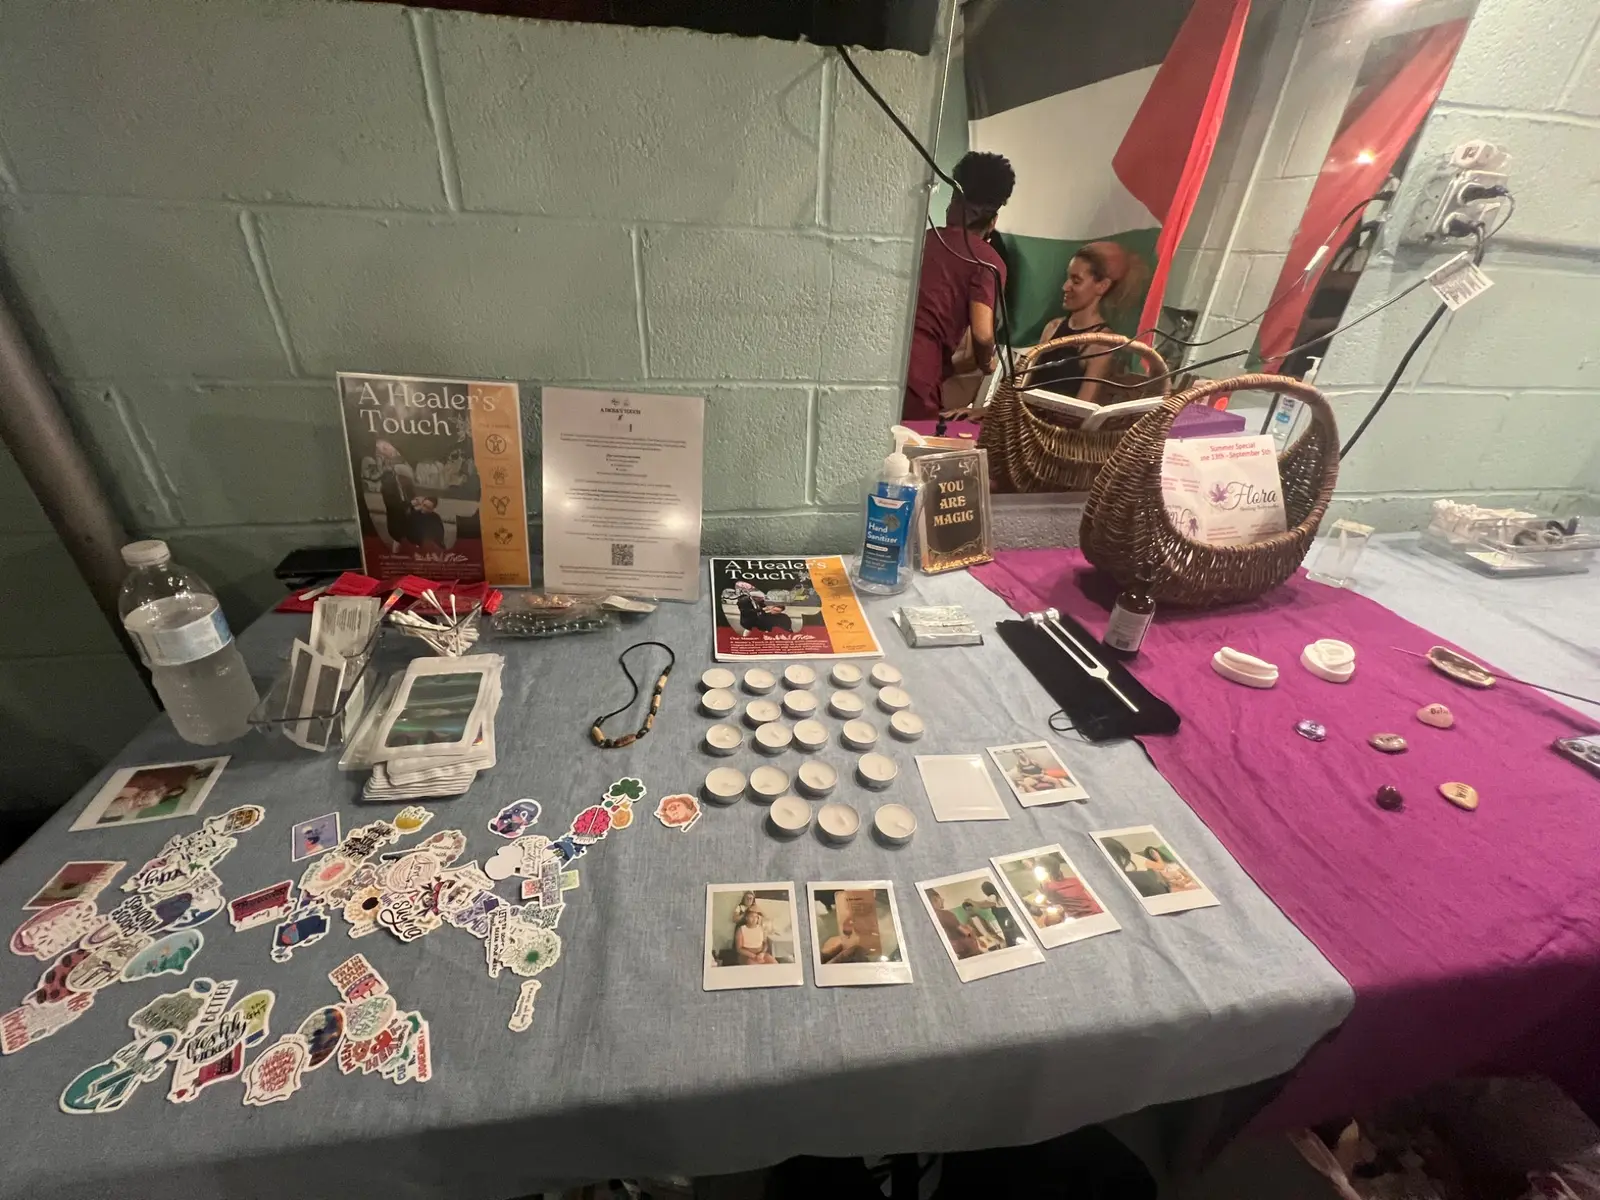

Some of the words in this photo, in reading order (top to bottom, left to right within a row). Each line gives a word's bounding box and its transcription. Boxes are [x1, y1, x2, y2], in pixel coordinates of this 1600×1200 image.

[358, 382, 381, 406] A
[387, 383, 496, 412] Healer's
[359, 409, 452, 436] Touch
[1209, 444, 1235, 453] Summer
[1235, 441, 1256, 450] Special
[1229, 450, 1260, 459] September
[938, 480, 965, 494] YOU
[939, 496, 967, 510] ARE
[1225, 481, 1277, 511] Flora
[933, 510, 975, 527] MAGIC
[868, 521, 888, 533] Hand
[867, 531, 898, 544] Sanitizer
[725, 560, 741, 570] A
[747, 559, 829, 570] Healer's
[725, 569, 795, 581] Touch
[331, 962, 350, 978] HOW
[351, 955, 361, 965] TO
[334, 958, 363, 980] TRAIN
[338, 964, 368, 985] YOUR
